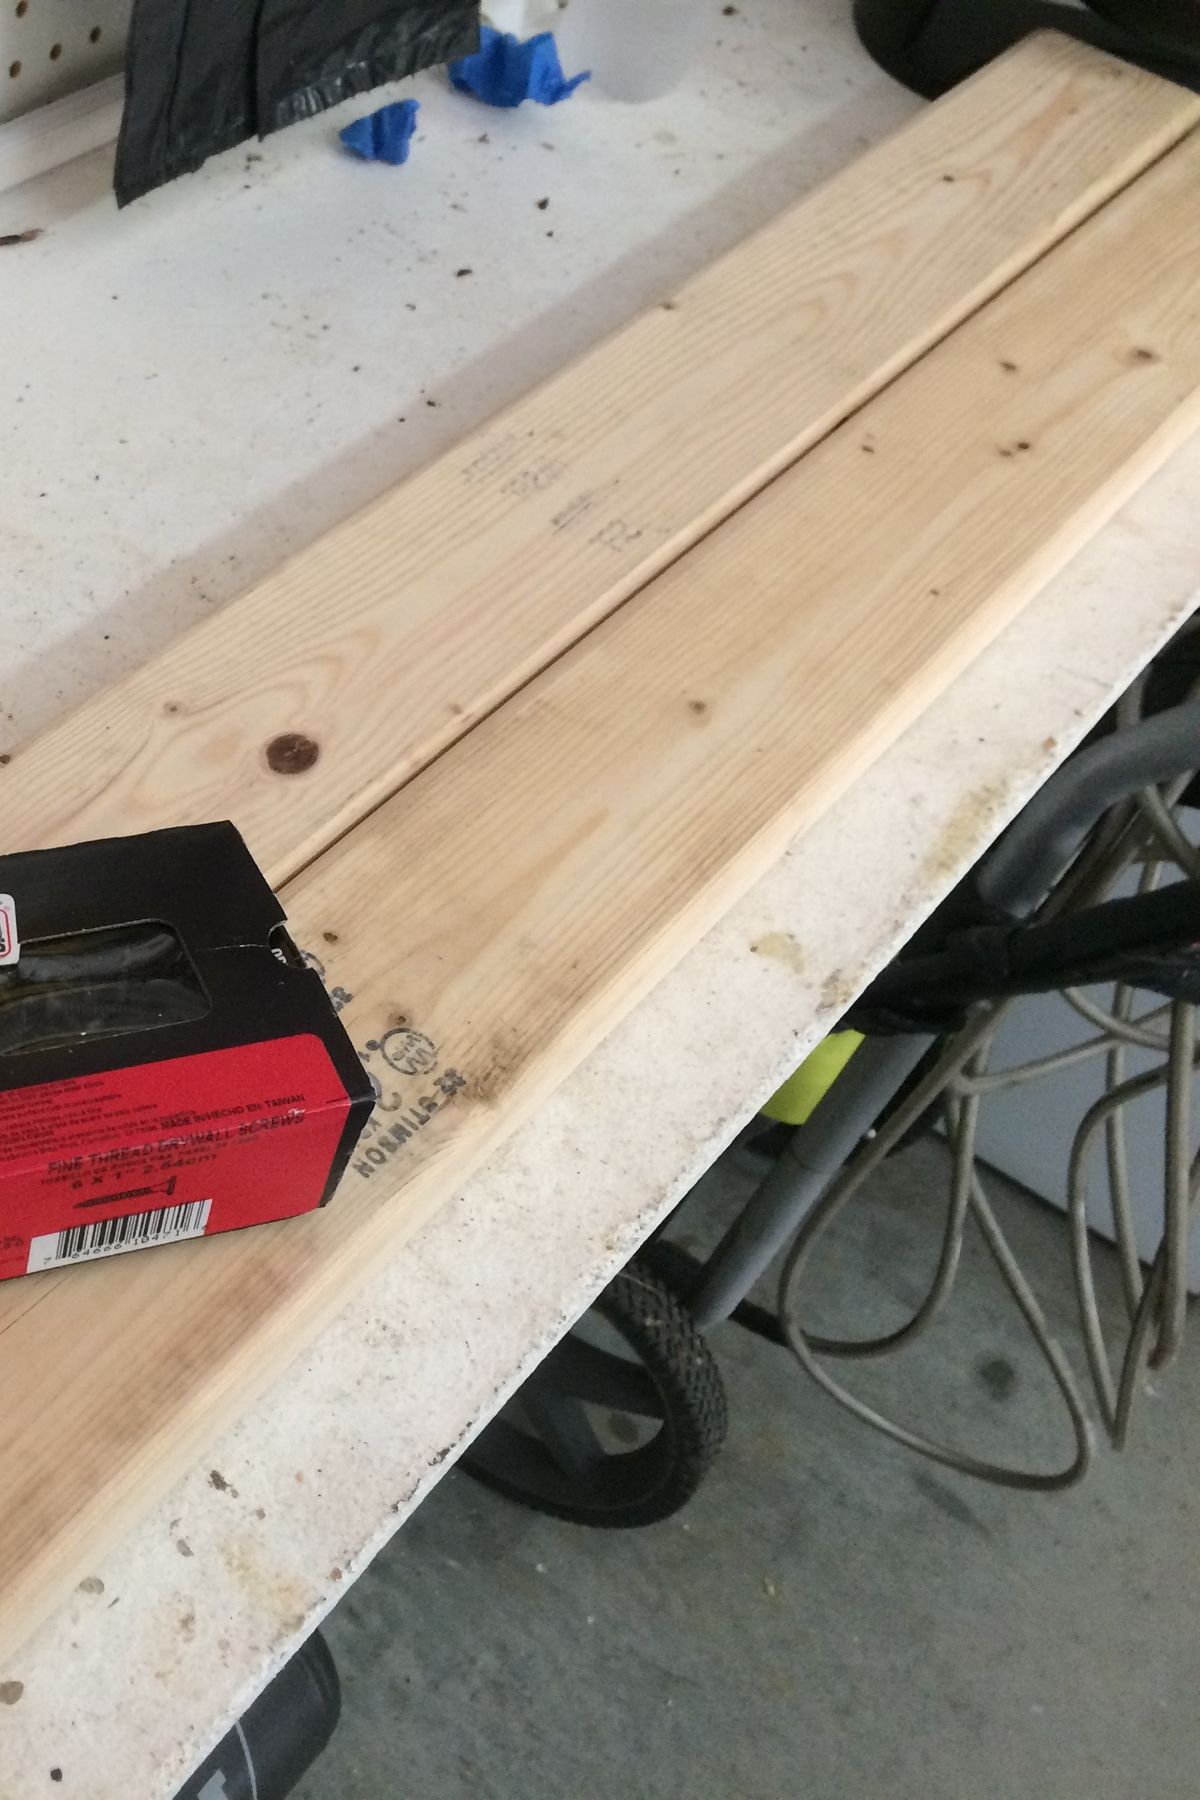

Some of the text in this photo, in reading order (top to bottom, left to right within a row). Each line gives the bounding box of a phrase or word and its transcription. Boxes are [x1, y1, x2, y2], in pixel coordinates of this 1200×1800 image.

[160, 1117, 191, 1130] MADE
[264, 1094, 306, 1109] TAIWAN
[48, 1157, 83, 1174] FINE
[89, 1144, 153, 1164] THREAD
[158, 1128, 233, 1151] DRYWALL
[237, 1111, 306, 1136] SCREWS
